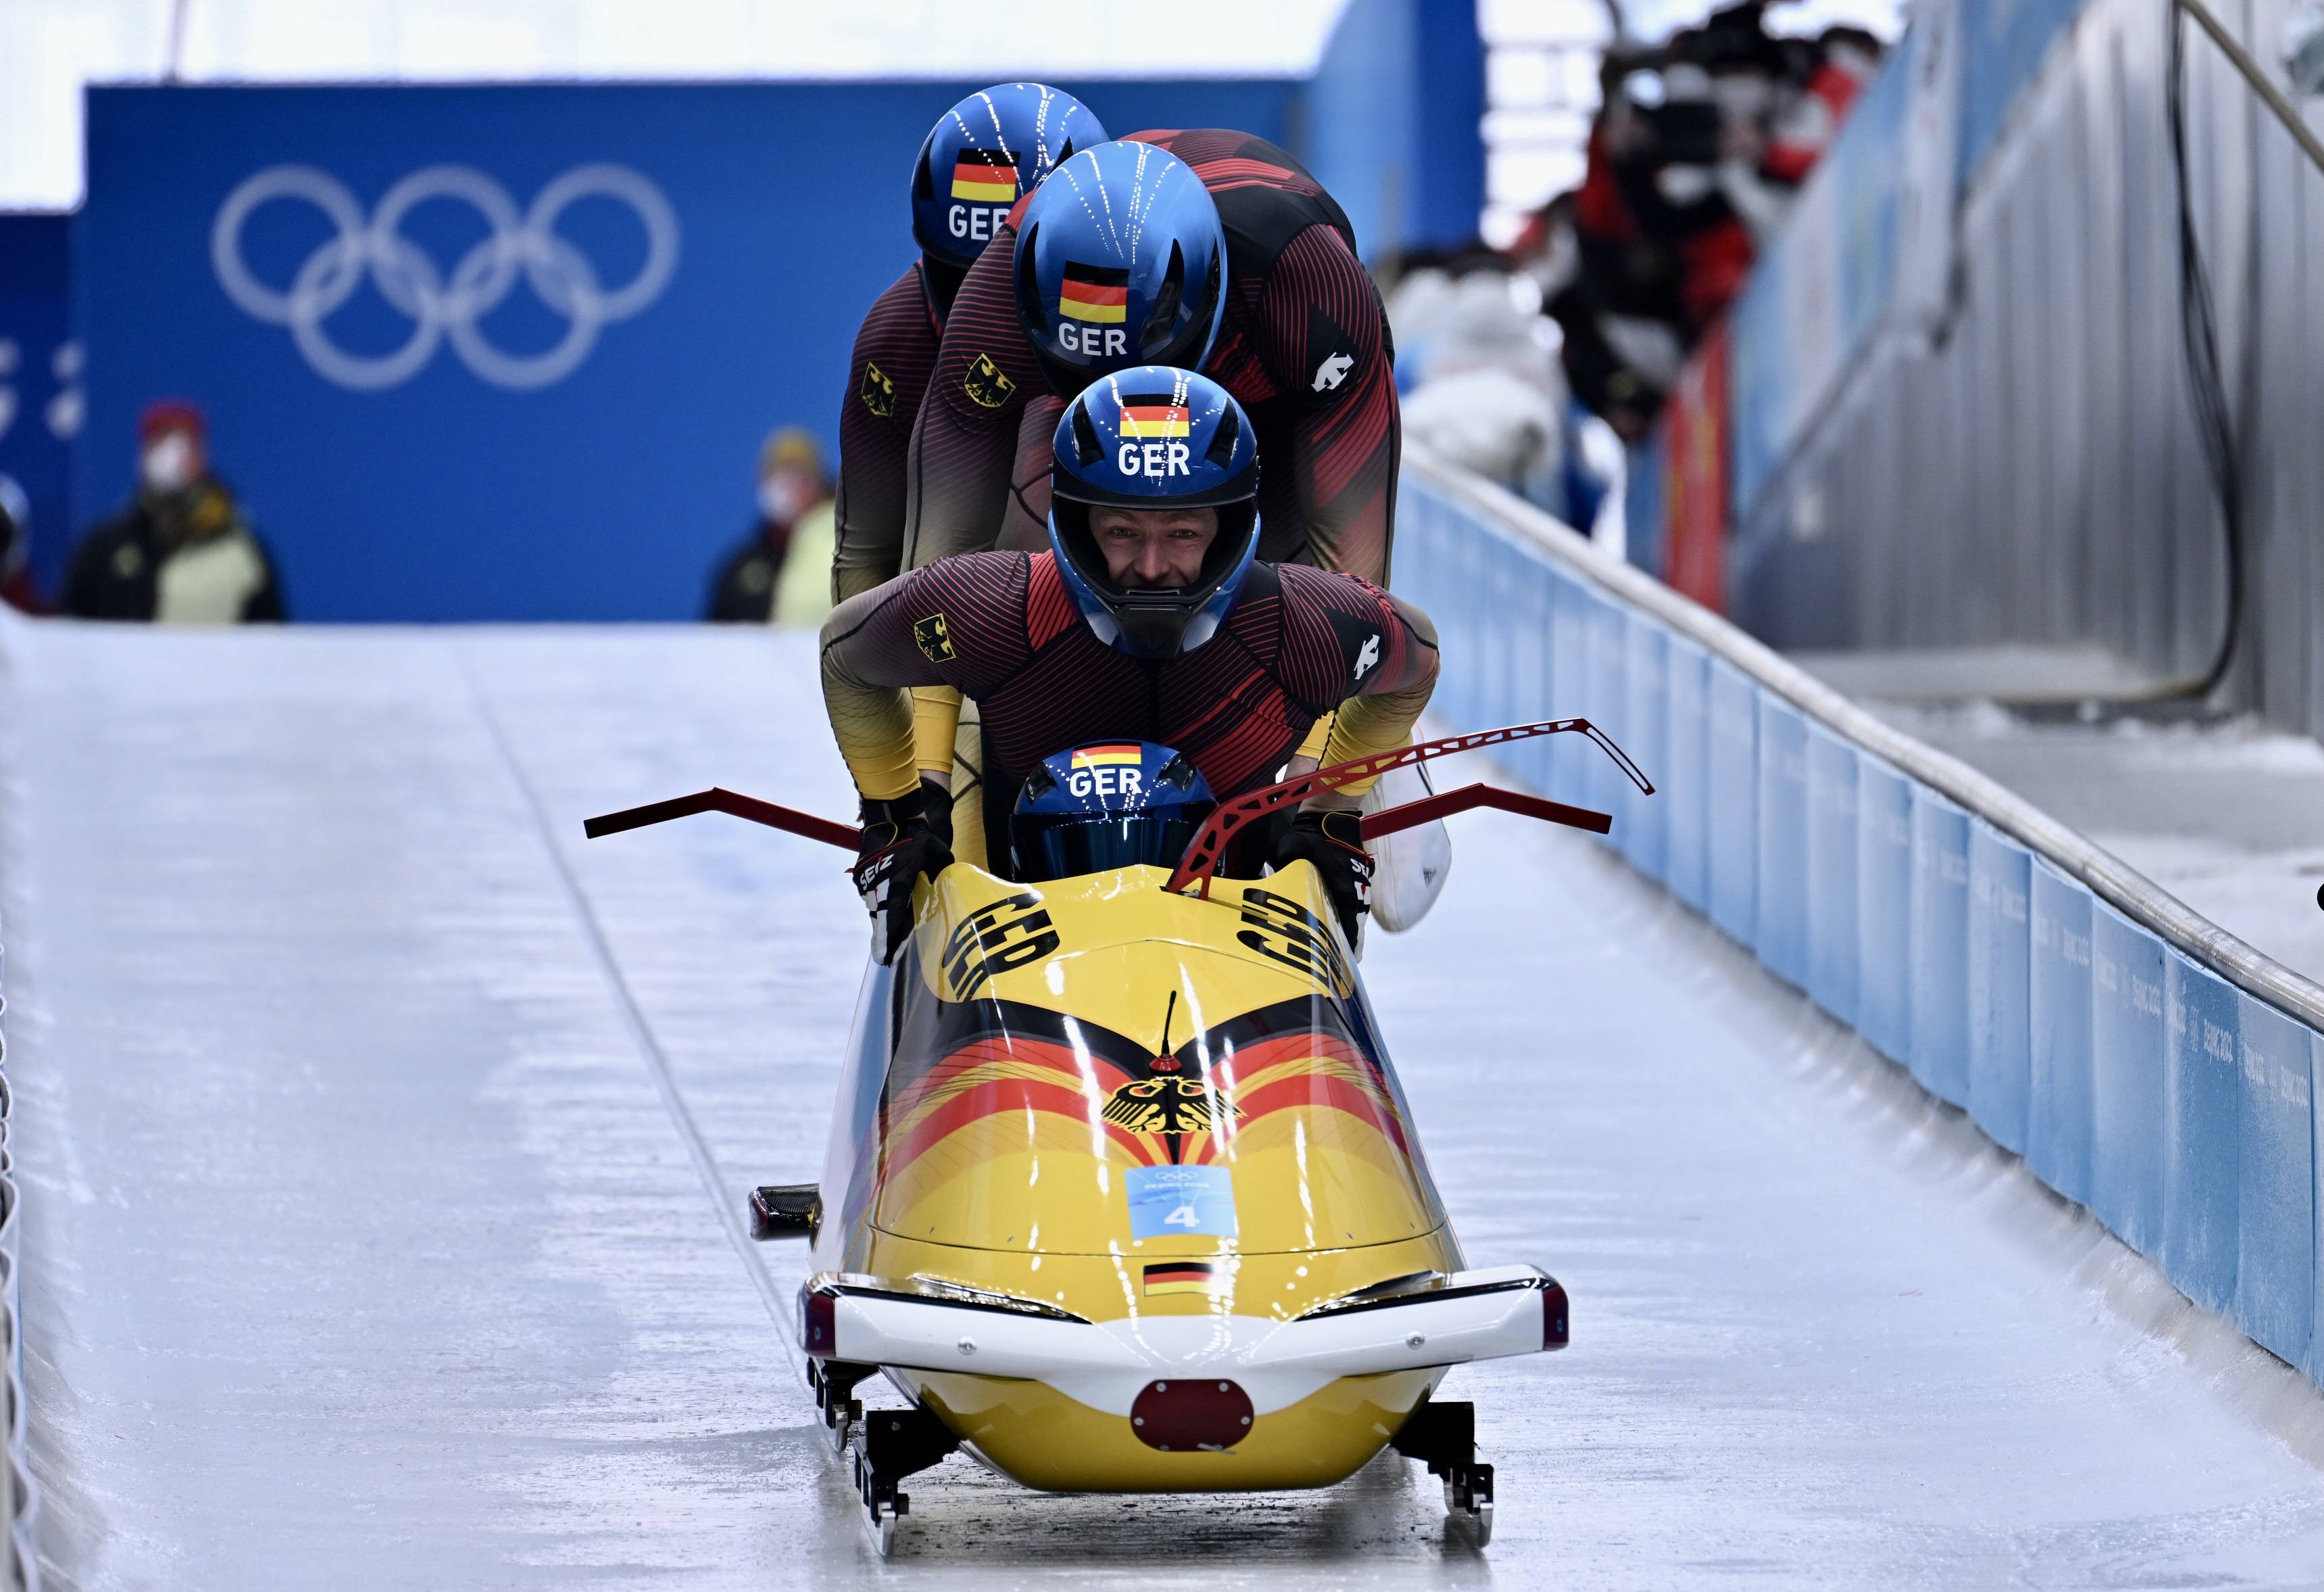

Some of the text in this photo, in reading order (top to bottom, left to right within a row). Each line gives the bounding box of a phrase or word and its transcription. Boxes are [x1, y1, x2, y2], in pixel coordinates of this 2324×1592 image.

[1058, 322, 1128, 356] GER
[1118, 443, 1191, 476] GER
[1070, 768, 1143, 797] GER
[859, 853, 895, 891] SEIZ
[942, 893, 1060, 1002] GER
[1164, 1206, 1200, 1227] 4
